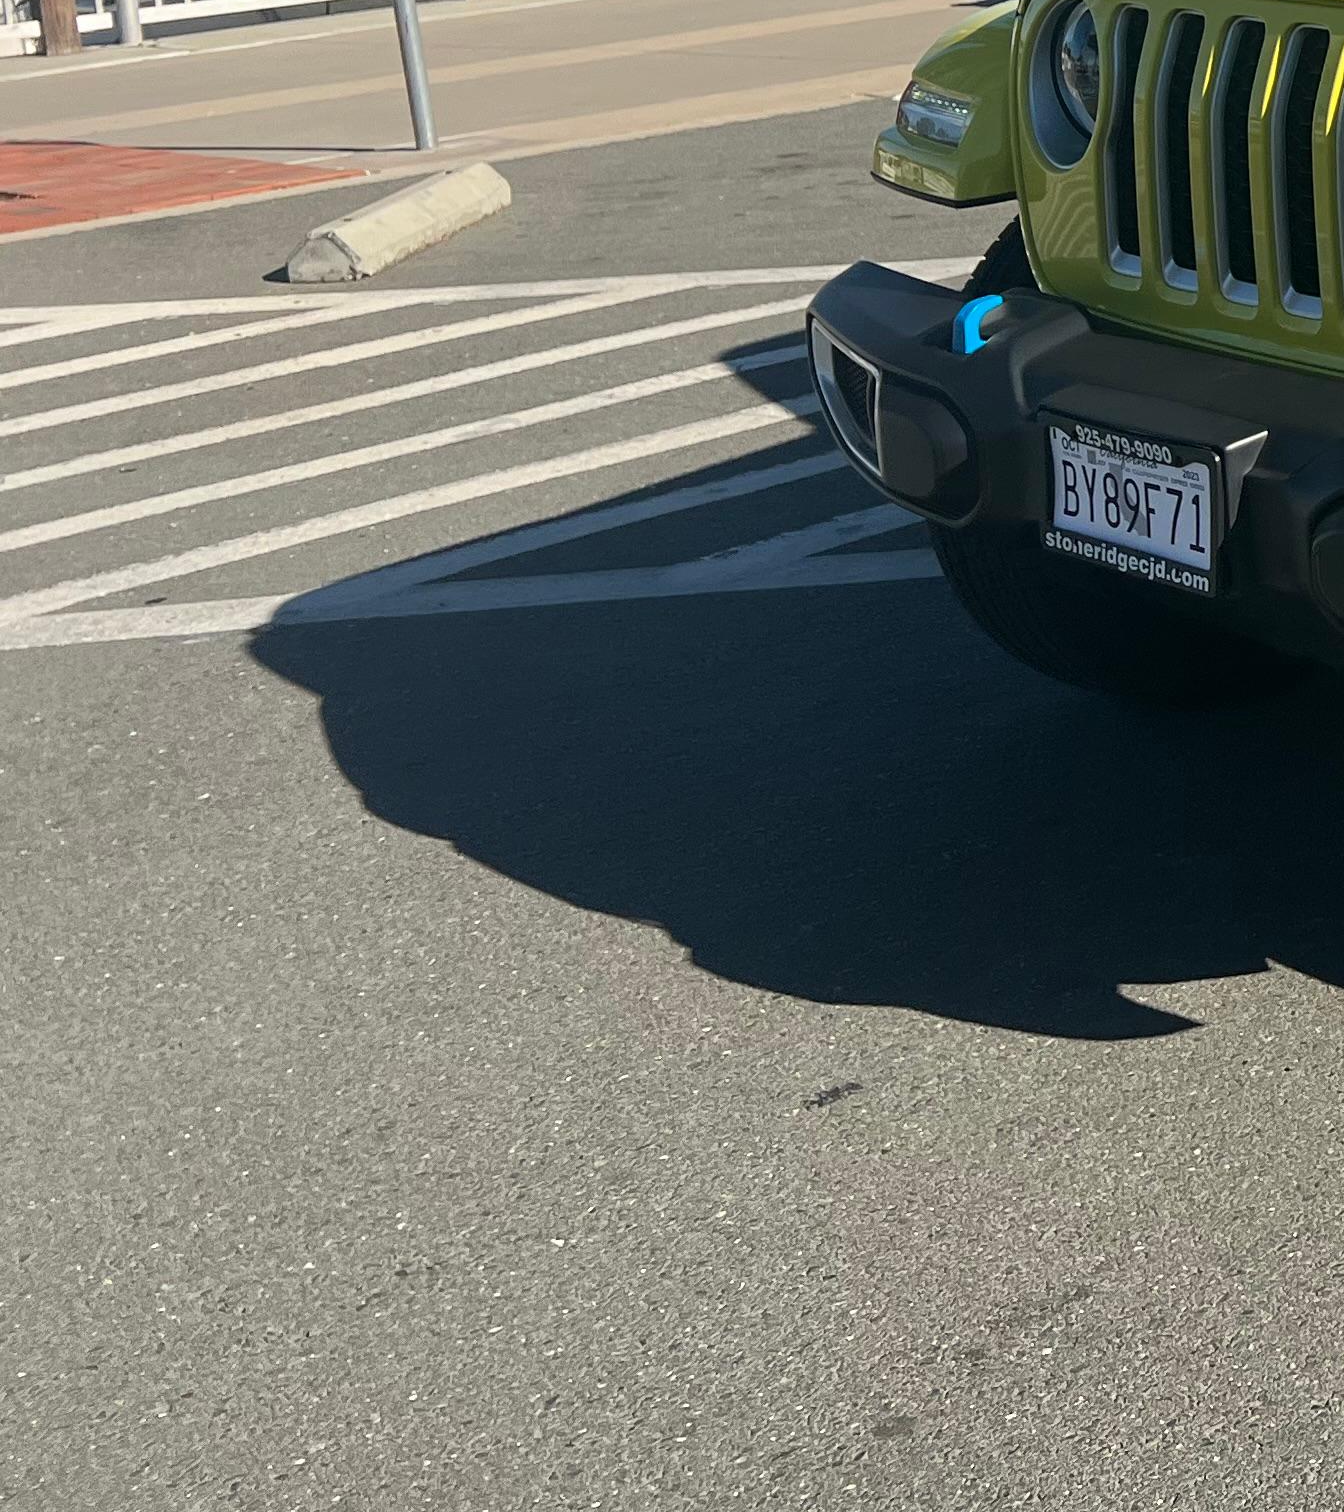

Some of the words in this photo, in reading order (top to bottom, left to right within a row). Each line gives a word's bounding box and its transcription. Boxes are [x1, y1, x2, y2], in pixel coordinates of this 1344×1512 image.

[1062, 438, 1080, 453] OCT
[1182, 469, 1200, 482] 2023
[1062, 460, 1206, 554] BY89F71
[1045, 530, 1210, 592] stoneridgecjd.com
